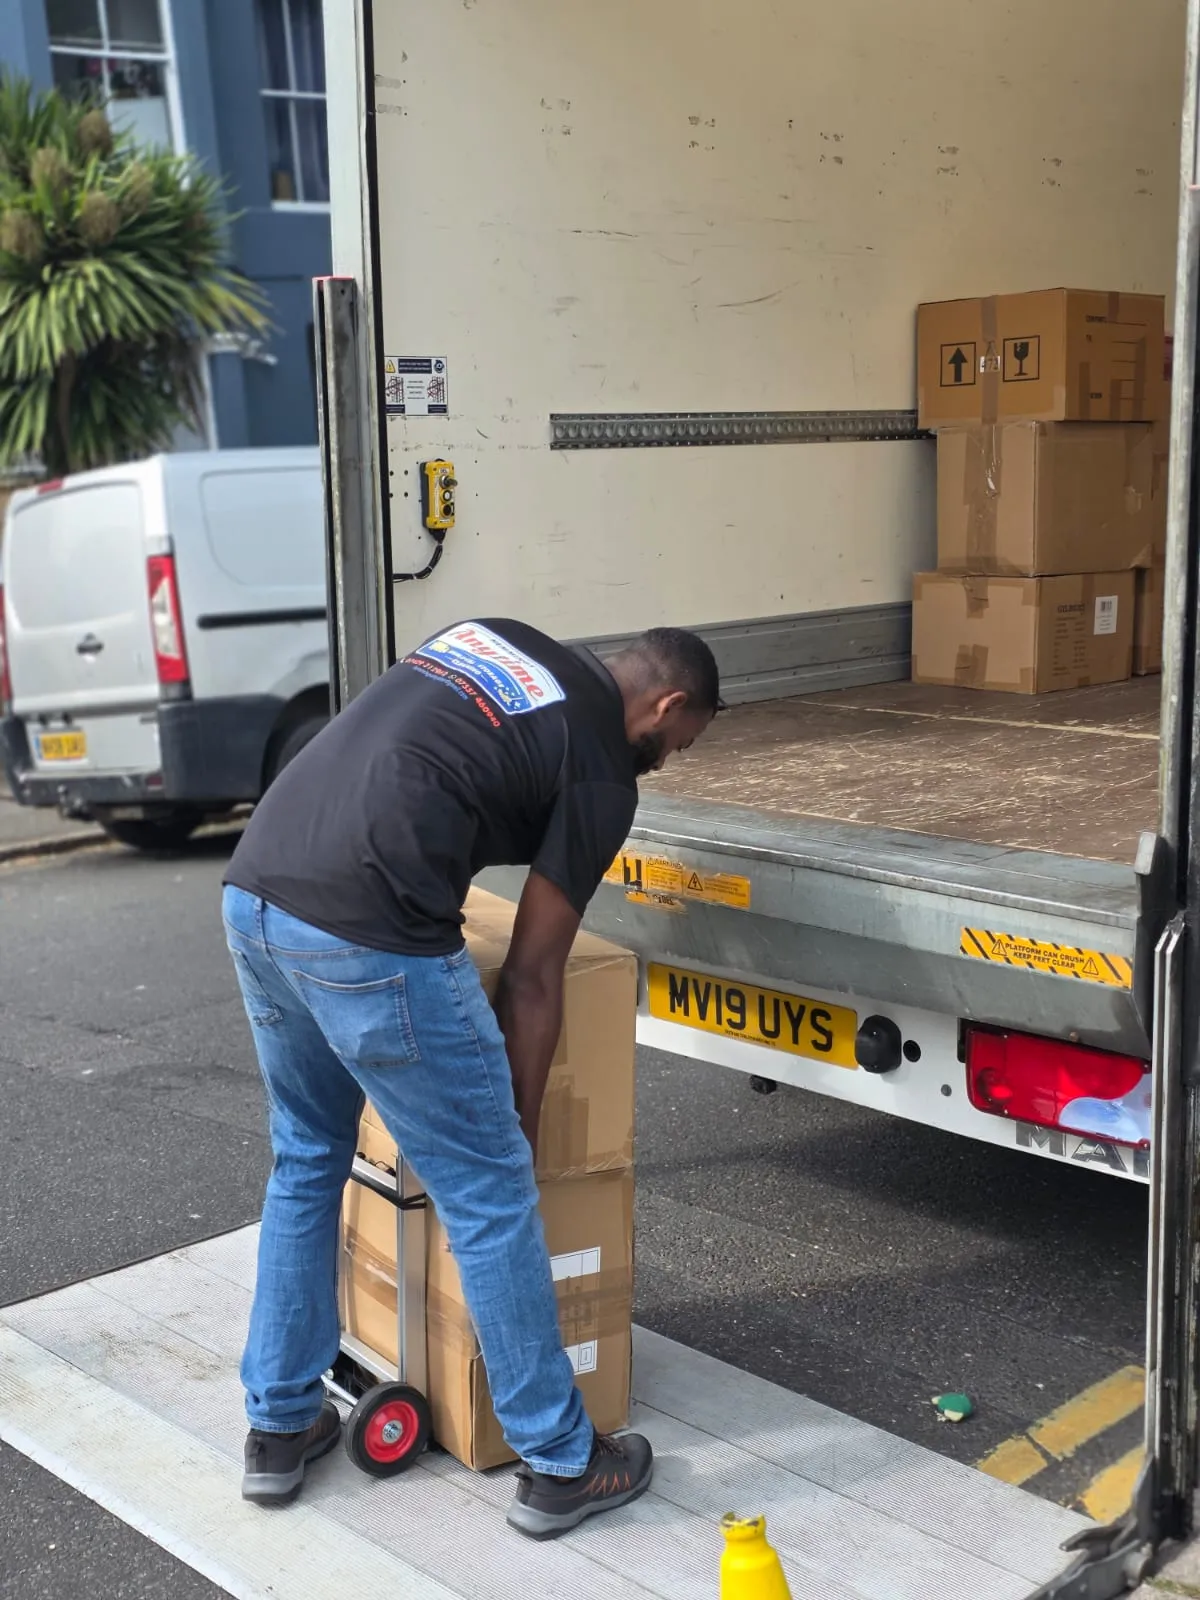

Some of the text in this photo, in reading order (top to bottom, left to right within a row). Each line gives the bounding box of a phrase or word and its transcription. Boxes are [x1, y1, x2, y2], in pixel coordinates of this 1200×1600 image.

[448, 629, 544, 698] Anytime
[1005, 943, 1085, 964] PLATFORM CAN CRUSH
[1013, 951, 1076, 969] KEEP FEET CLEAR
[669, 973, 834, 1053] MV19 UYS
